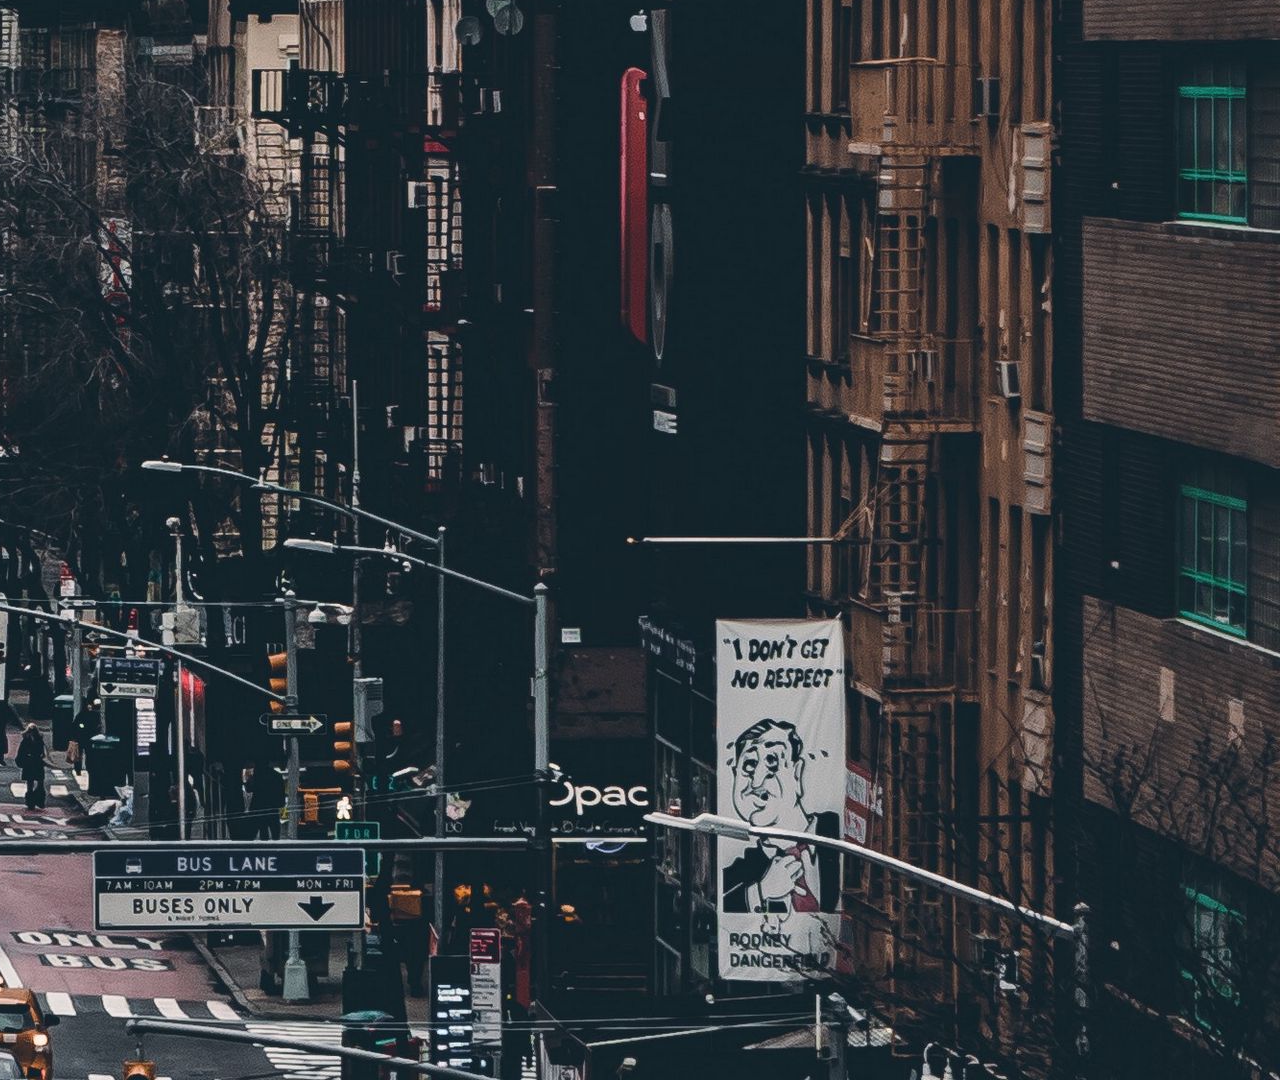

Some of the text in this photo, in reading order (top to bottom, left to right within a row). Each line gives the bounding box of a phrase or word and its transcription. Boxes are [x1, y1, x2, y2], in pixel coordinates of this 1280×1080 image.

[748, 634, 798, 662] DON'T
[801, 639, 829, 659] GET
[731, 669, 759, 690] NO
[177, 856, 278, 871] BUS LANE
[133, 898, 254, 914] BUSES ONLY
[17, 931, 166, 951] ONLY
[43, 953, 168, 971] BUS
